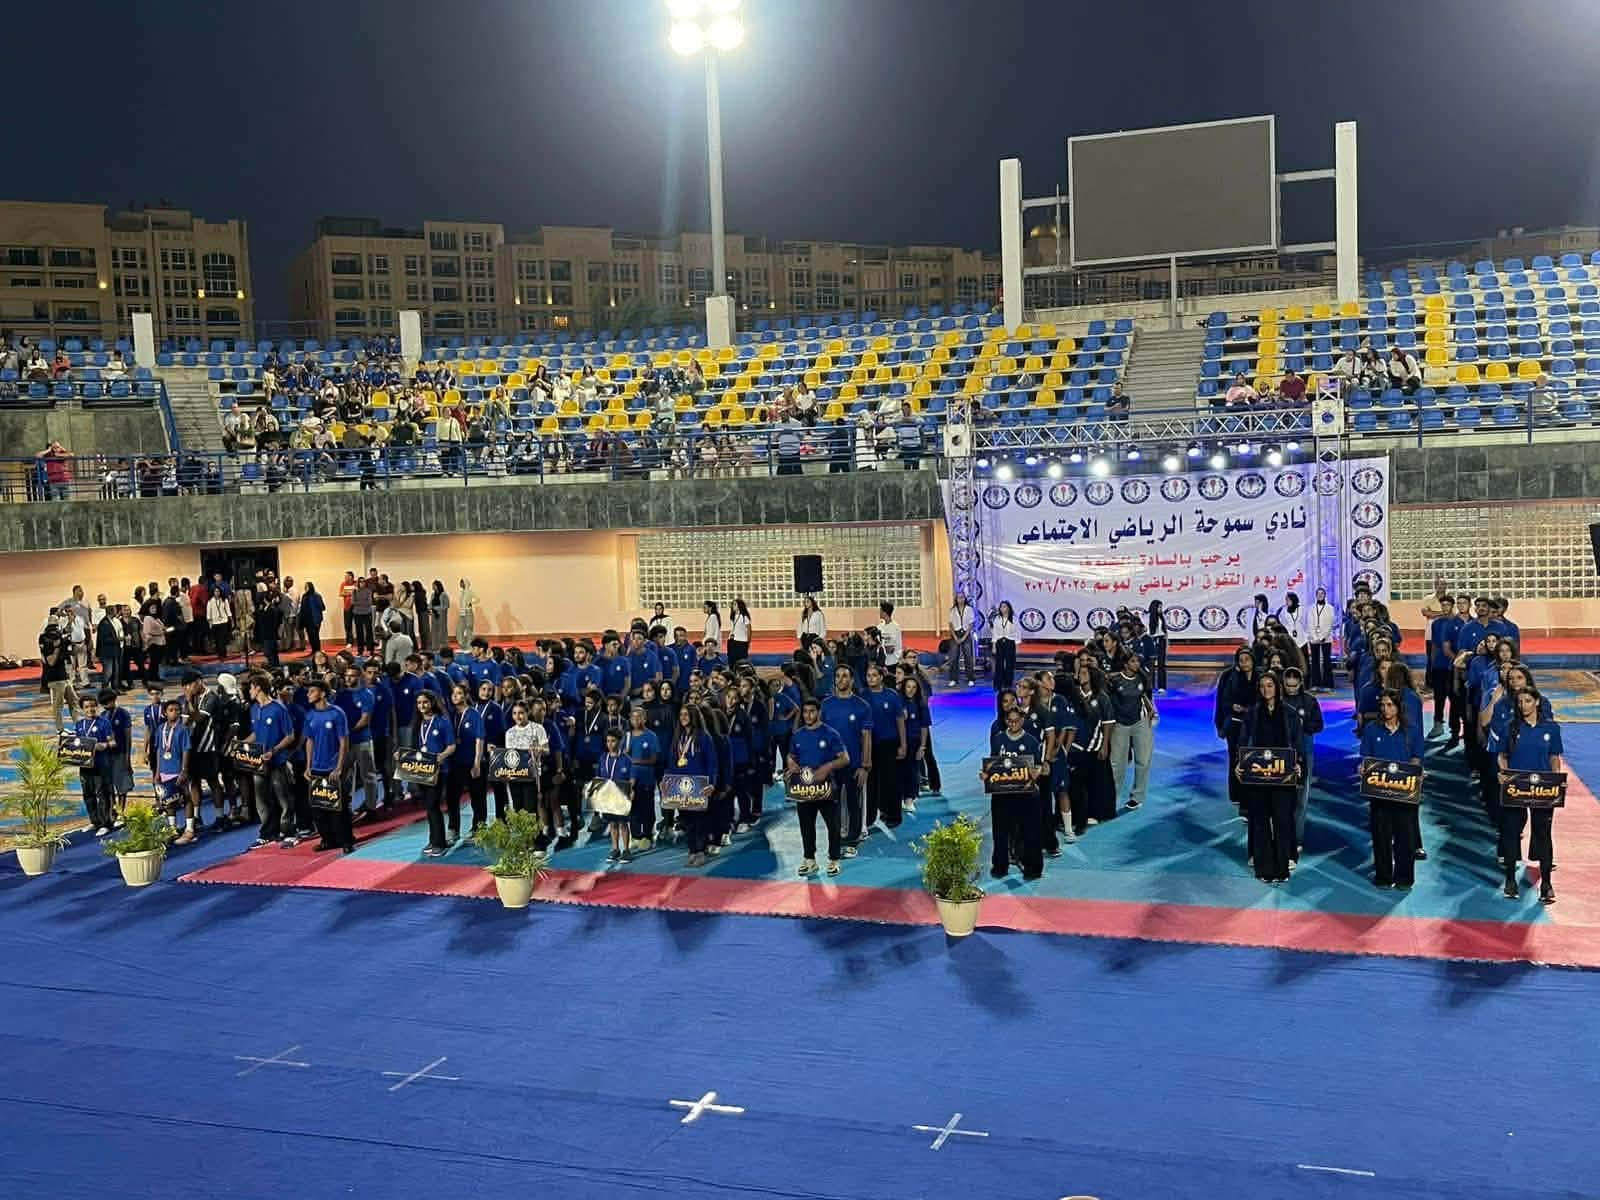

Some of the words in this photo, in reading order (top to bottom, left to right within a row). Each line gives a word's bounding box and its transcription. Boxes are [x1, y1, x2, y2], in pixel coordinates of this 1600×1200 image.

[1109, 512, 1183, 549] الرياضي
[1194, 508, 1254, 538] سموحة
[1265, 505, 1306, 541] نادي
[1200, 552, 1241, 568] يرحب
[1139, 575, 1195, 595] الرياضي
[1253, 575, 1278, 589] يوم
[1287, 568, 1305, 590] في
[990, 767, 1029, 783] القدم
[1251, 759, 1285, 776] اليد
[1367, 771, 1416, 791] السلة
[1507, 784, 1559, 797] الطائرة
